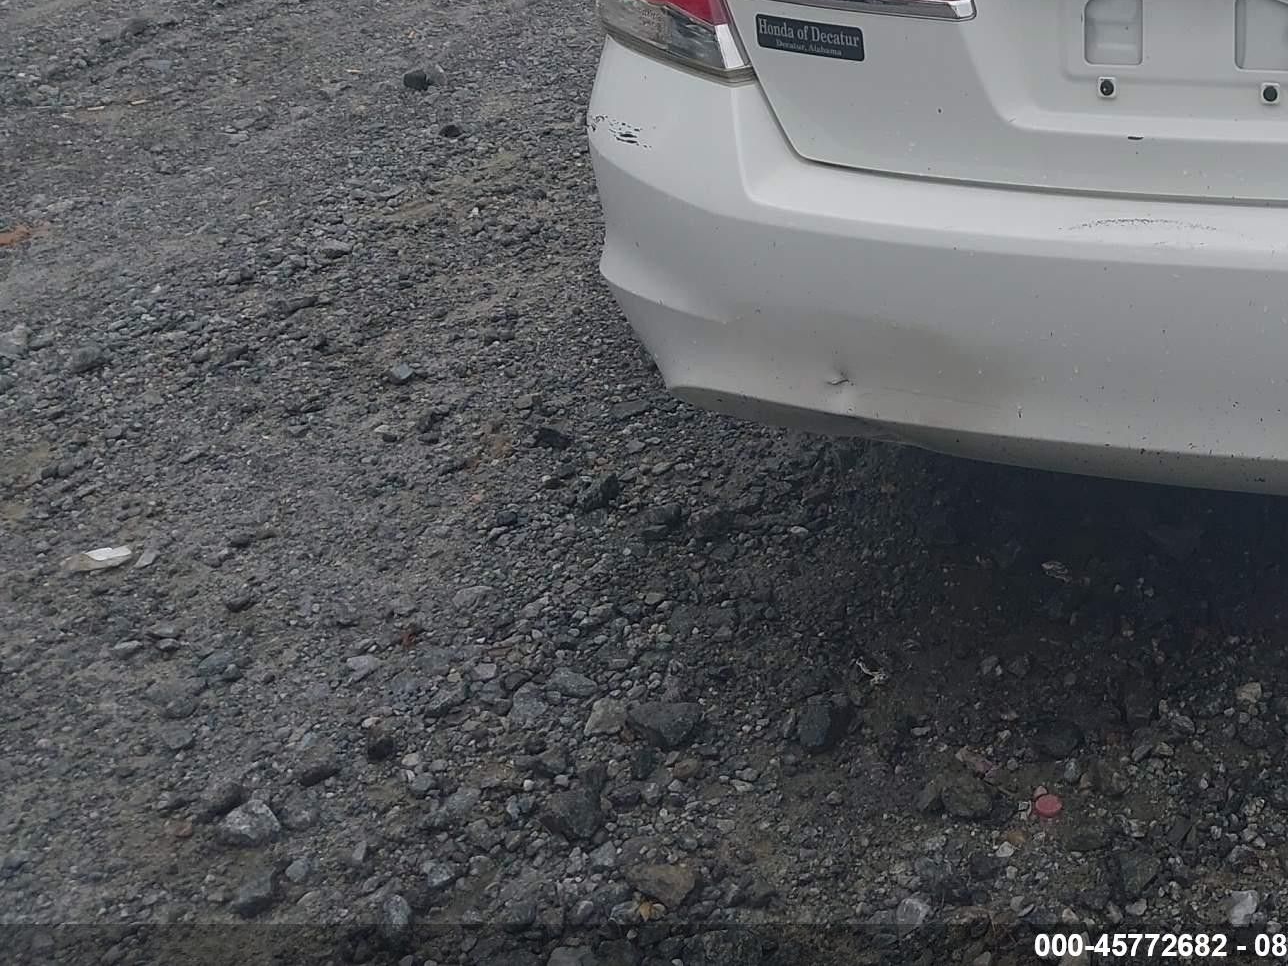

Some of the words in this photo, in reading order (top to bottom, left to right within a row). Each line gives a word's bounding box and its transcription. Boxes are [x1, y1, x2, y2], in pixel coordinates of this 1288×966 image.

[758, 18, 794, 38] Honda
[797, 25, 809, 40] of
[811, 26, 860, 47] Decatur
[808, 44, 842, 56] Alabama
